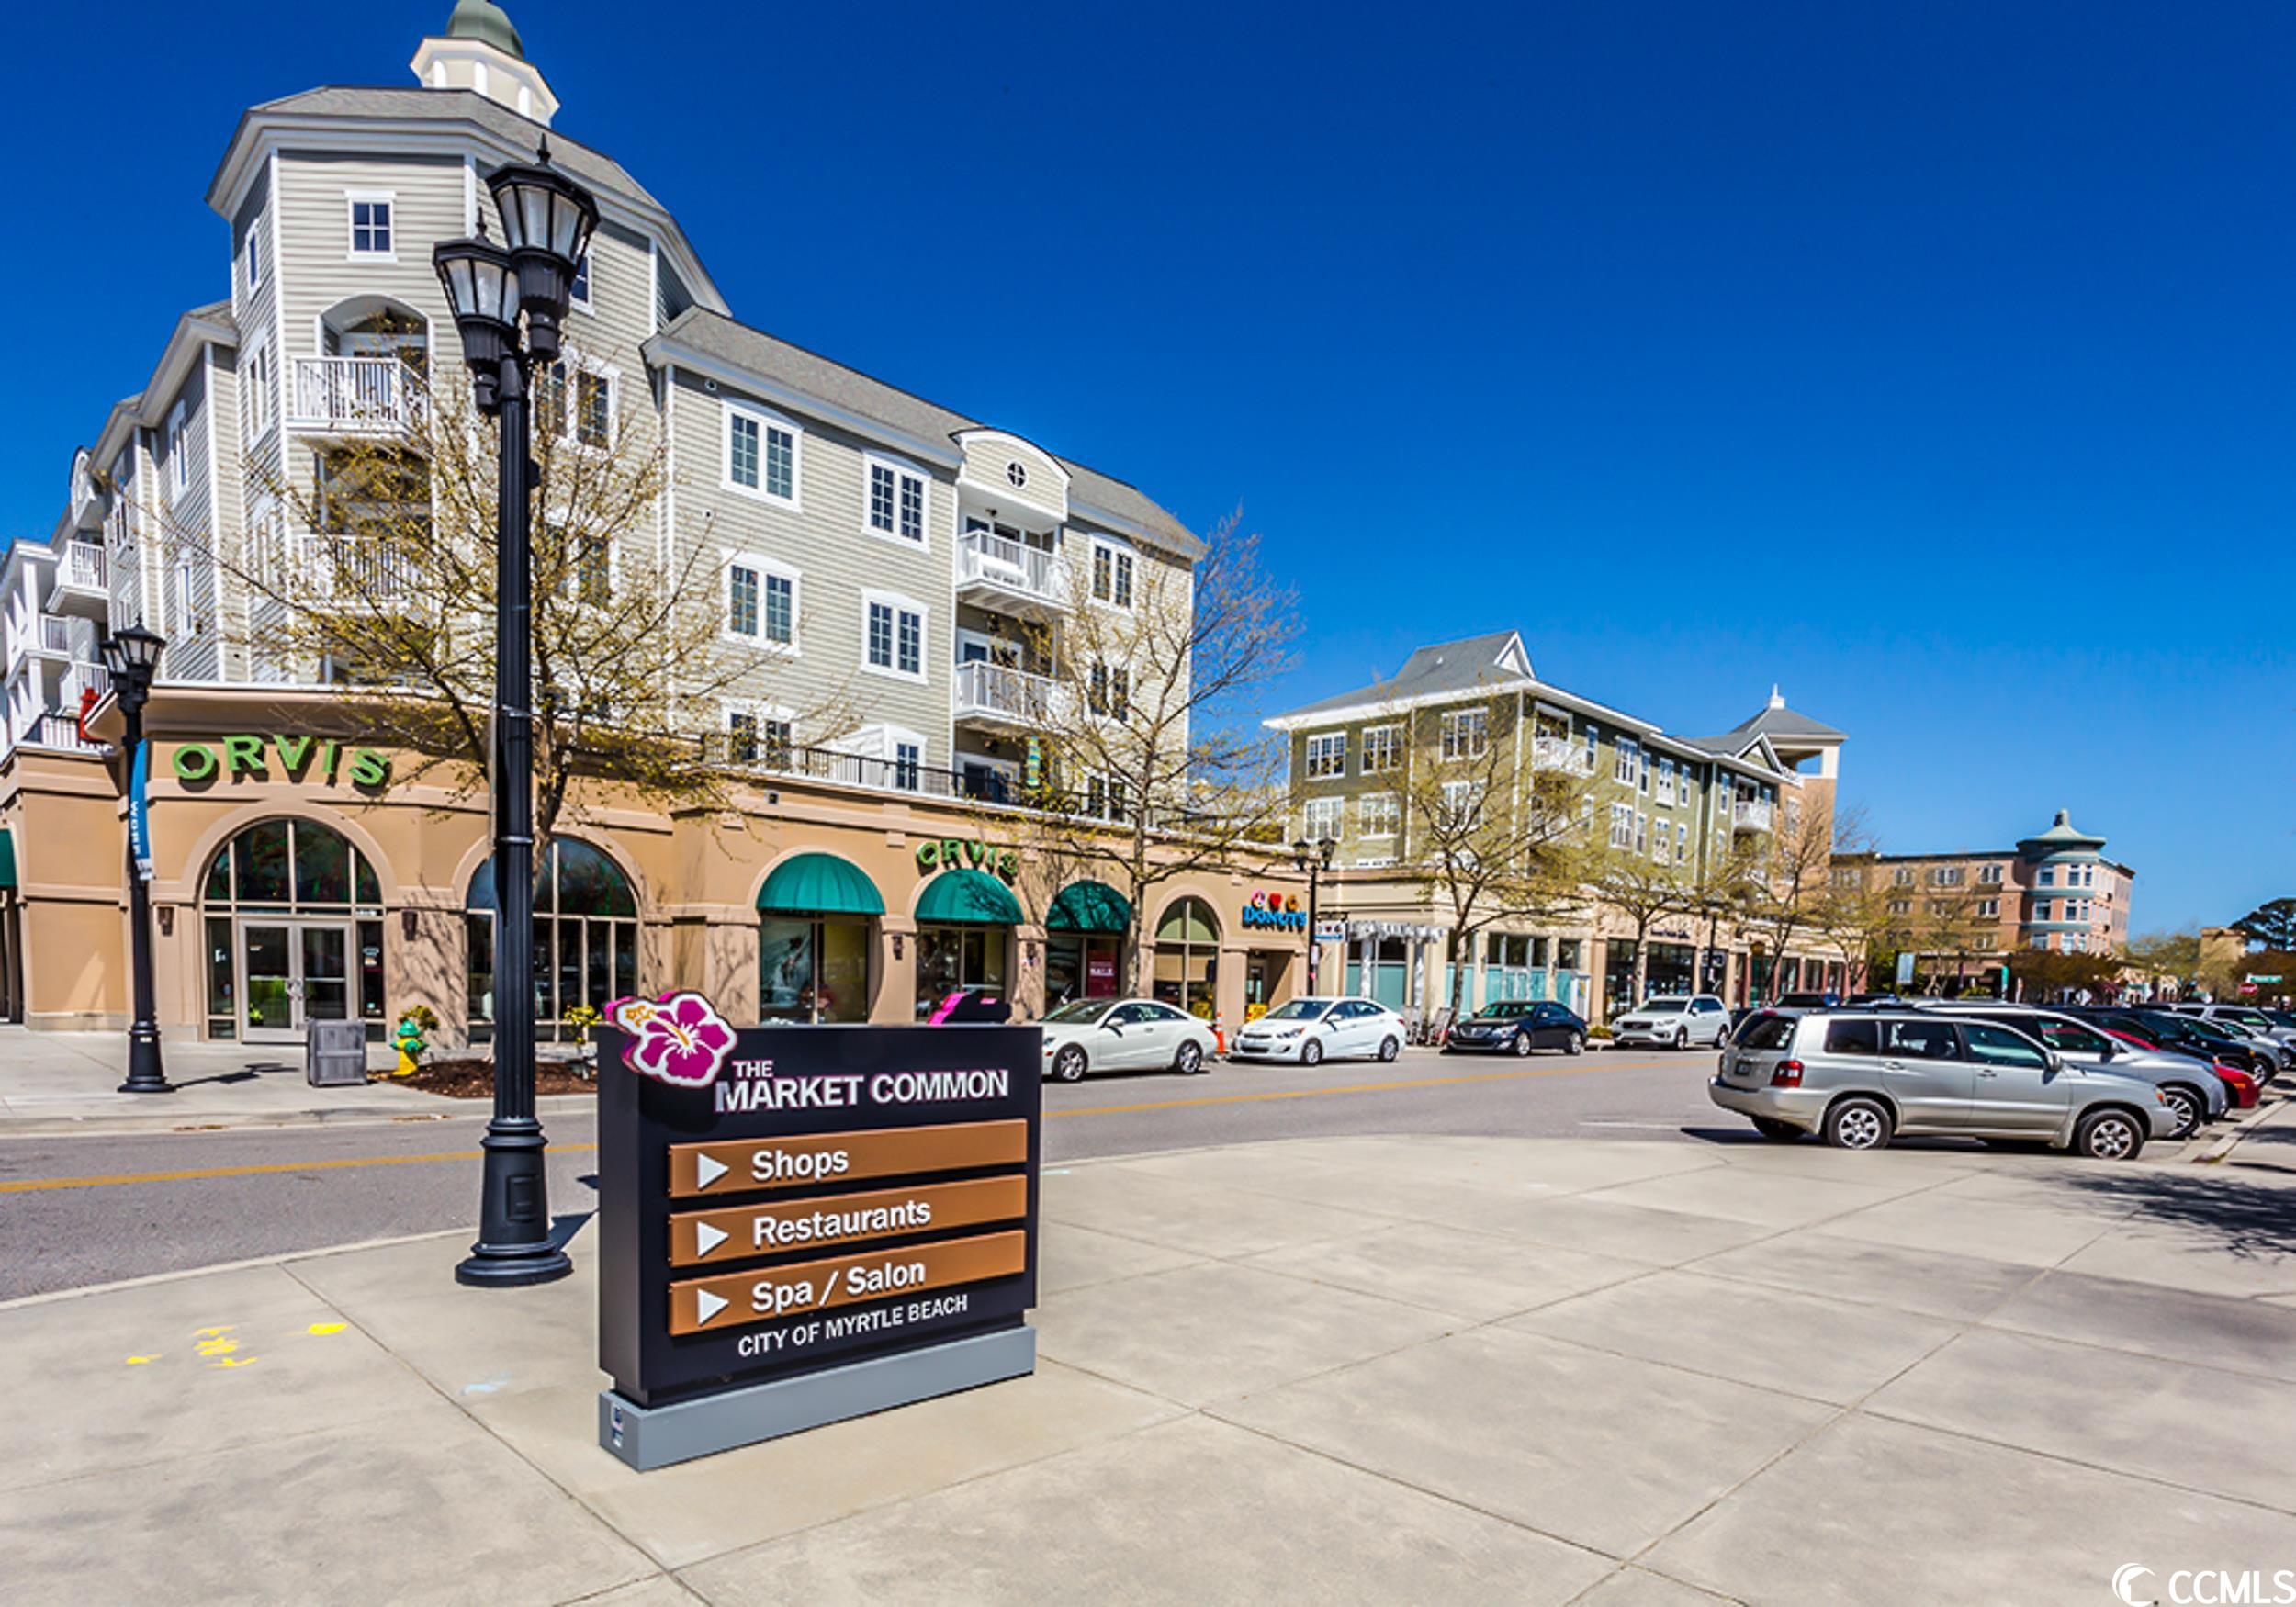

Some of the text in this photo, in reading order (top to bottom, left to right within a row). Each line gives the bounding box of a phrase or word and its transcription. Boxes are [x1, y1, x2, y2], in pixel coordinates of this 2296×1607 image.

[172, 734, 390, 785] ORVIS
[917, 838, 1019, 875] ORVIS
[1242, 905, 1308, 927] DONUTS
[715, 1069, 1008, 1112] MARKET COMMON
[732, 1060, 773, 1078] THE
[751, 1150, 850, 1181] Shops
[753, 1199, 931, 1247] Restaurants
[750, 1261, 927, 1315] Spa / Salon
[737, 1293, 969, 1357] CITY OF MYRTLE BEACH
